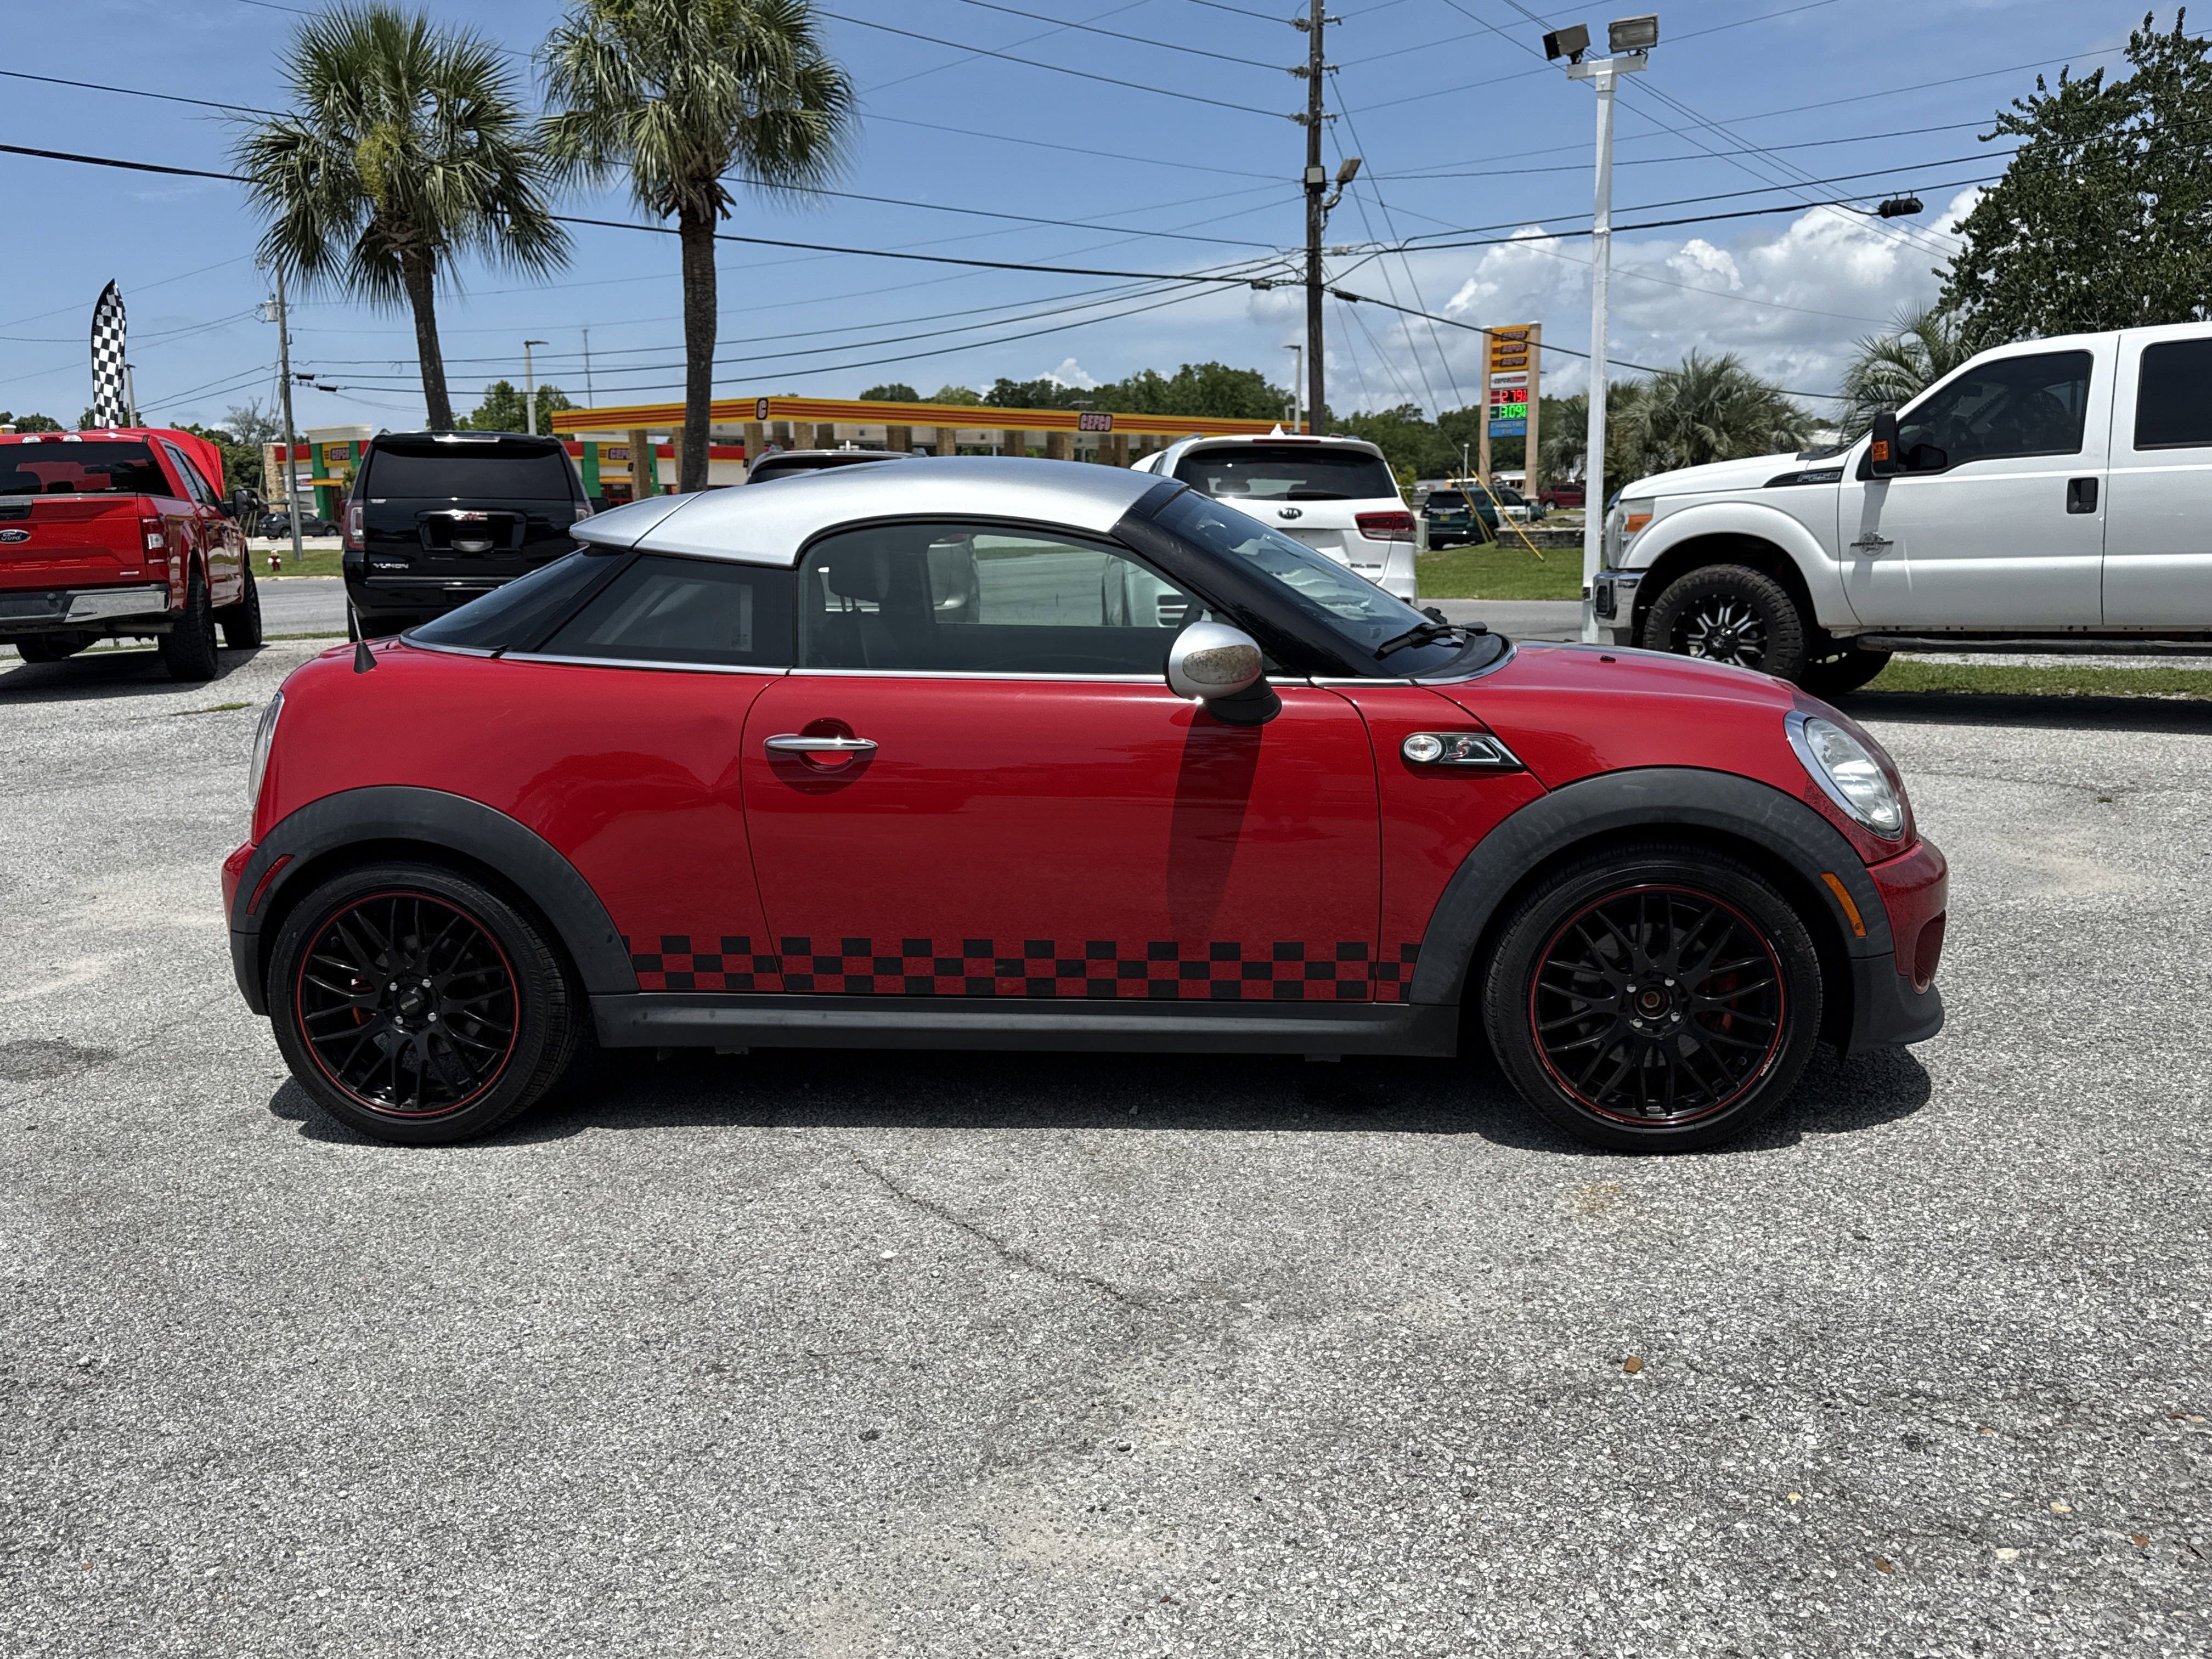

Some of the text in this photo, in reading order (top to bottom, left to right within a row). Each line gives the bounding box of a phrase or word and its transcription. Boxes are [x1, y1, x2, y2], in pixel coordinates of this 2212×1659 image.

[758, 399, 767, 419] C
[1080, 414, 1111, 431] CEFCO
[454, 511, 488, 521] GMC
[1280, 507, 1300, 517] KIA
[1, 532, 22, 541] Ford
